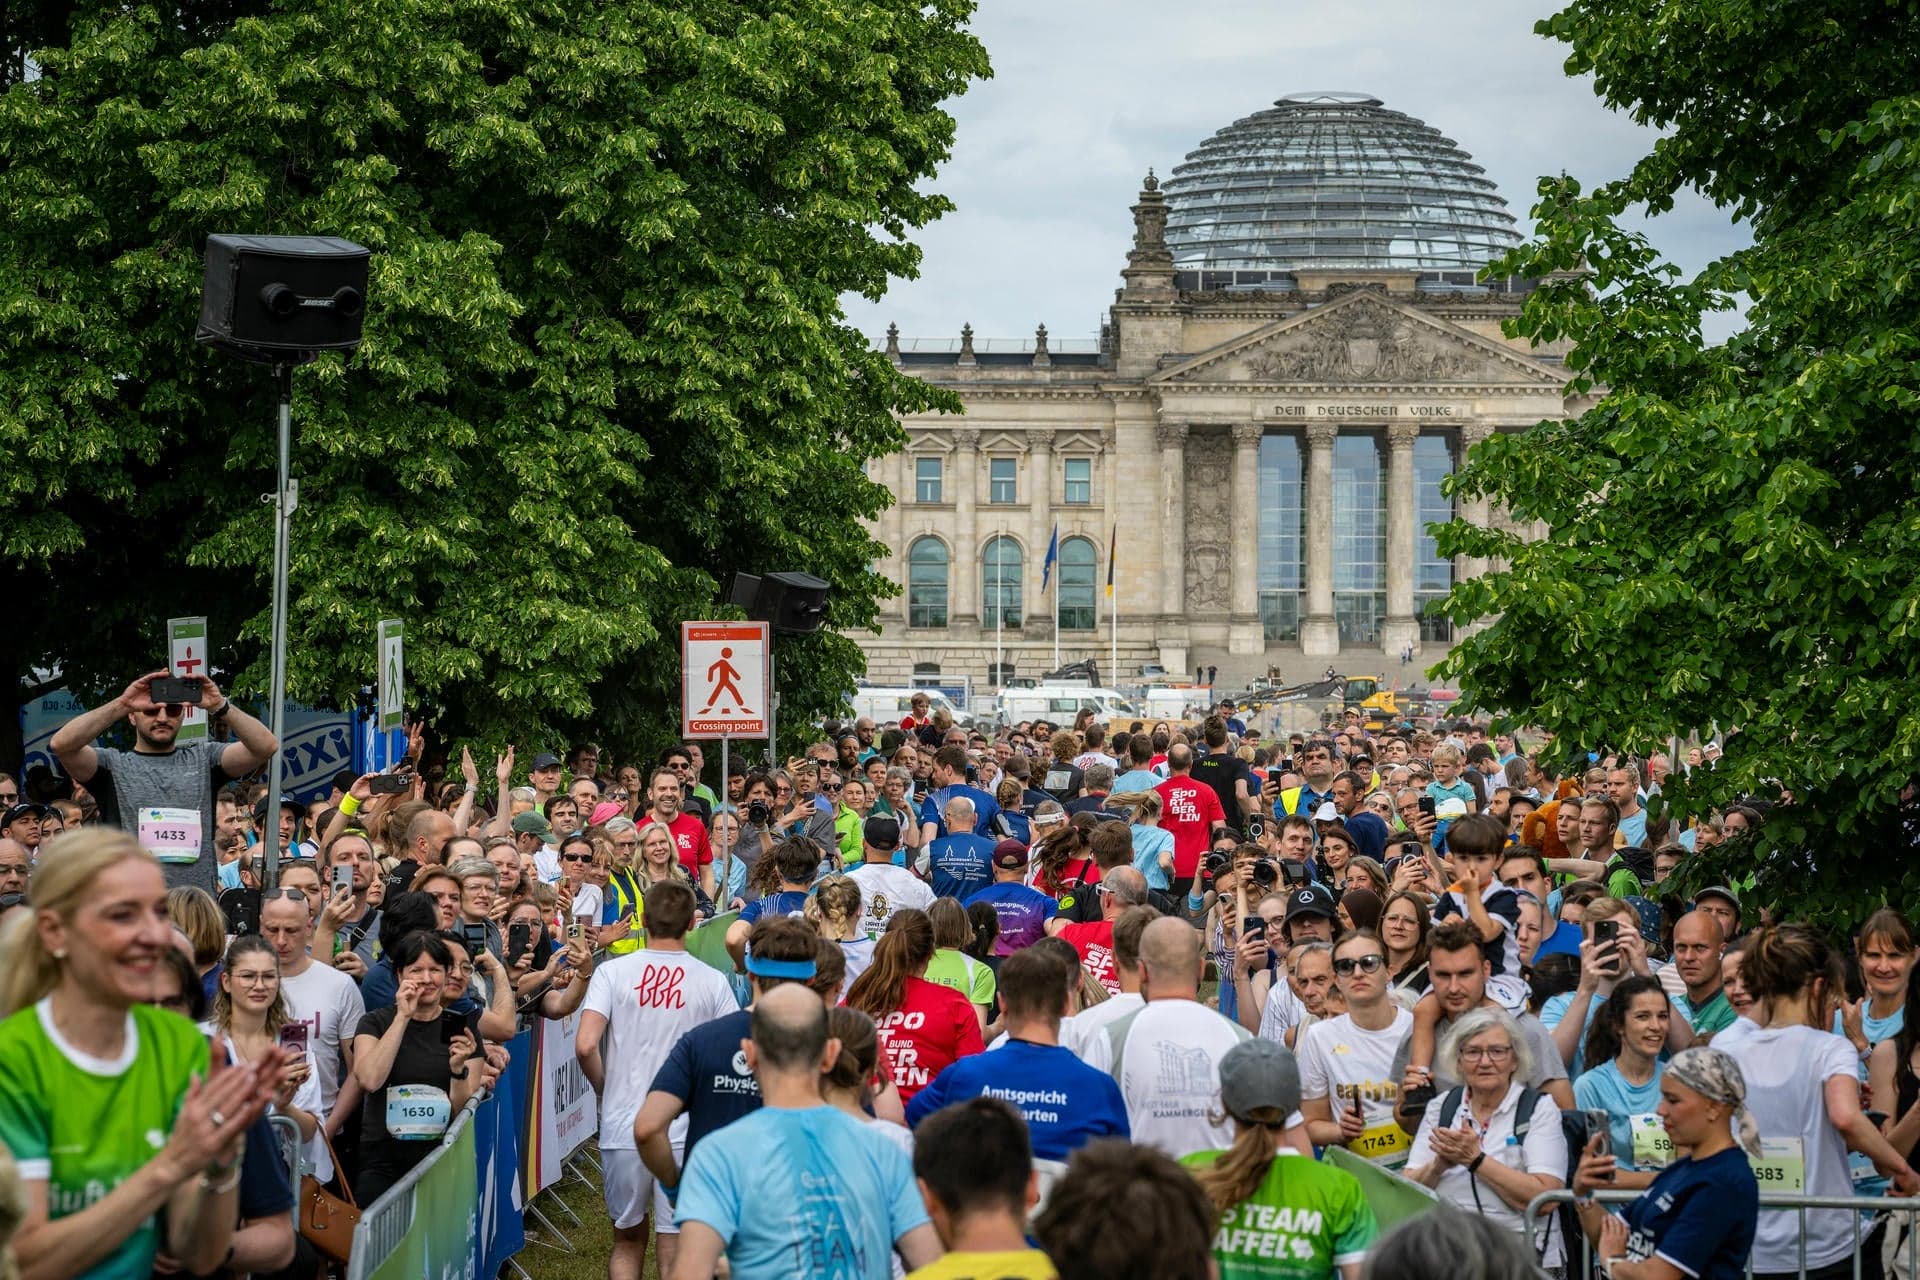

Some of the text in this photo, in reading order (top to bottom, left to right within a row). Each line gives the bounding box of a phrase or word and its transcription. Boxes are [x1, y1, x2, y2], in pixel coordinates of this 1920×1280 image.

[1274, 405, 1452, 416] DEM DEUTSCHEN VOLKE
[692, 721, 760, 732] Crossing point
[1171, 790, 1198, 799] SPO
[1169, 798, 1186, 807] RT
[1172, 805, 1196, 814] BER
[1179, 813, 1201, 822] LIN
[154, 830, 186, 841] 1433
[634, 964, 686, 1010] bbh
[889, 1039, 914, 1048] BUND
[981, 1084, 1068, 1106] Amtsgericht
[402, 1106, 435, 1117] 1630
[1362, 1134, 1396, 1150] 1743
[1243, 1203, 1323, 1236] TEAM
[1211, 1227, 1289, 1260] AFFEL
